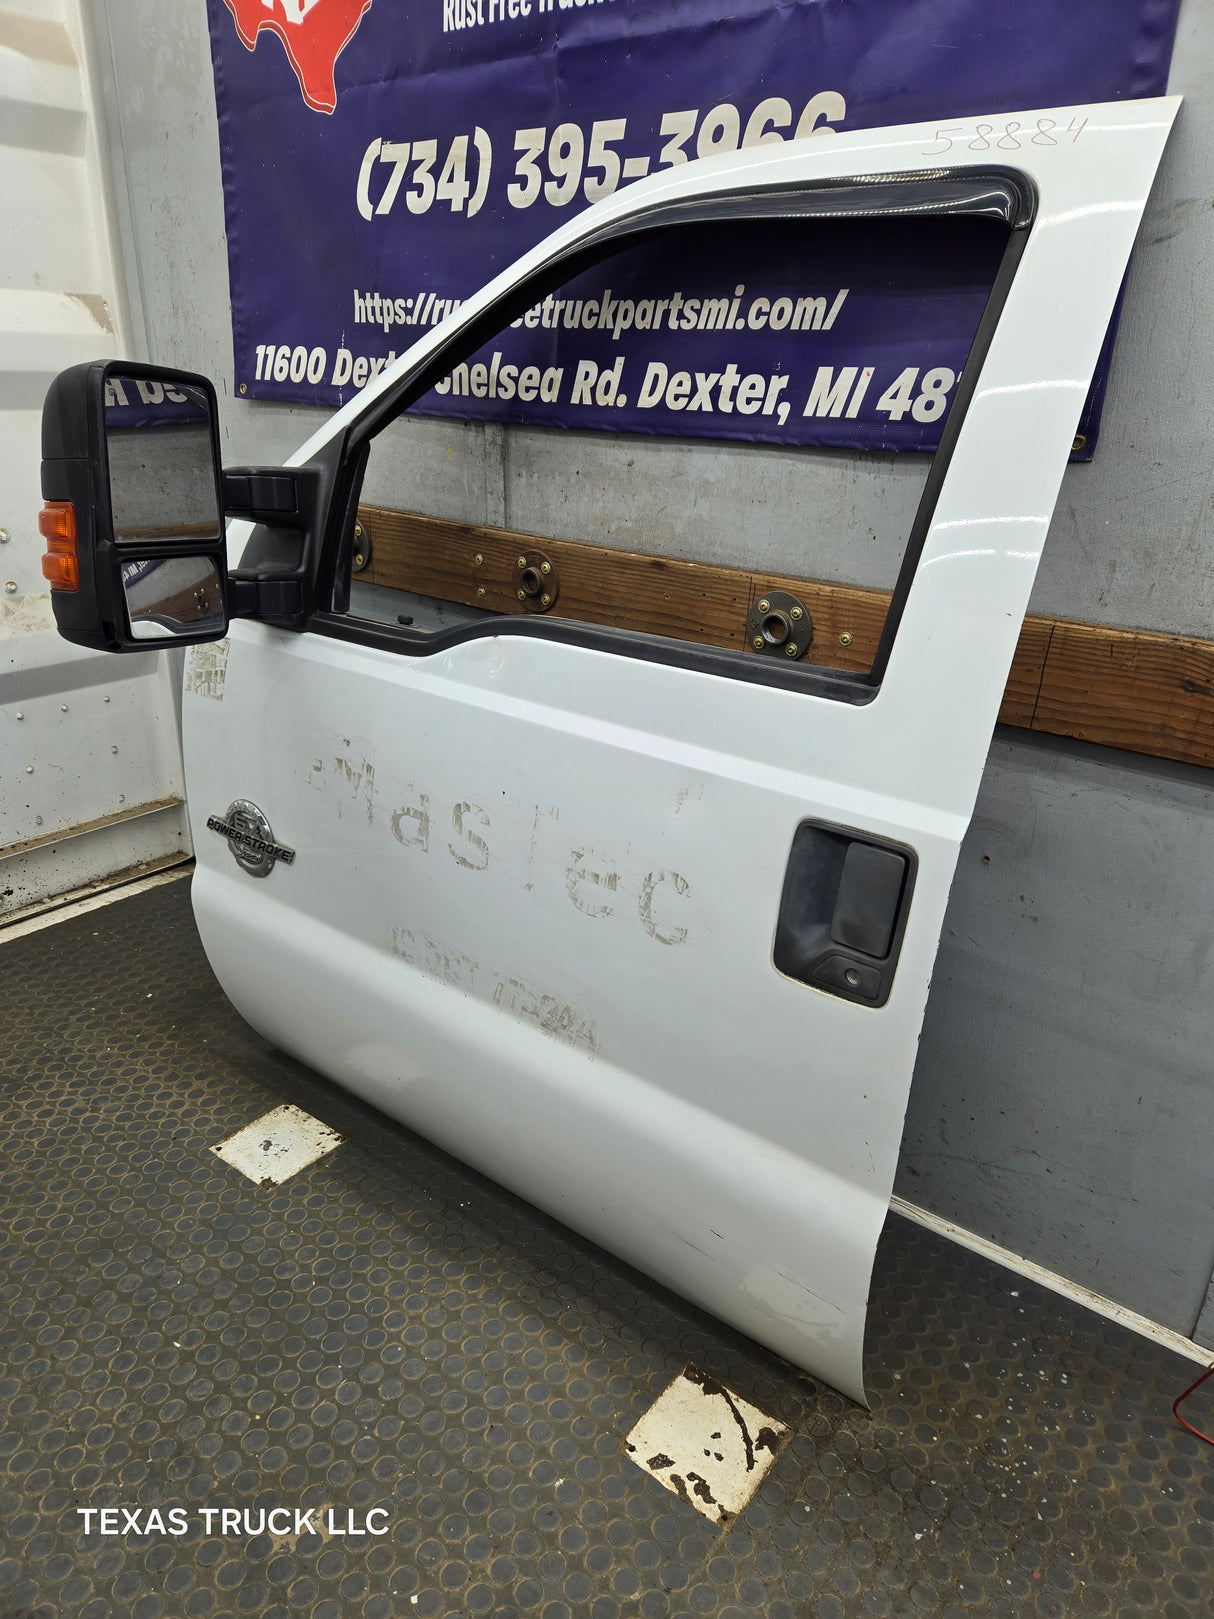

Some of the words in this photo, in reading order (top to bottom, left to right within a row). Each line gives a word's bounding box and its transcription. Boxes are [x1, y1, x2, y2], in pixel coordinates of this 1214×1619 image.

[356, 126, 493, 222] (734)
[921, 117, 1089, 156] 58884
[255, 345, 328, 384] 11600
[570, 357, 628, 408] Rd.
[636, 361, 791, 426] Dexter,
[802, 366, 876, 418] MI
[875, 366, 963, 423] 48
